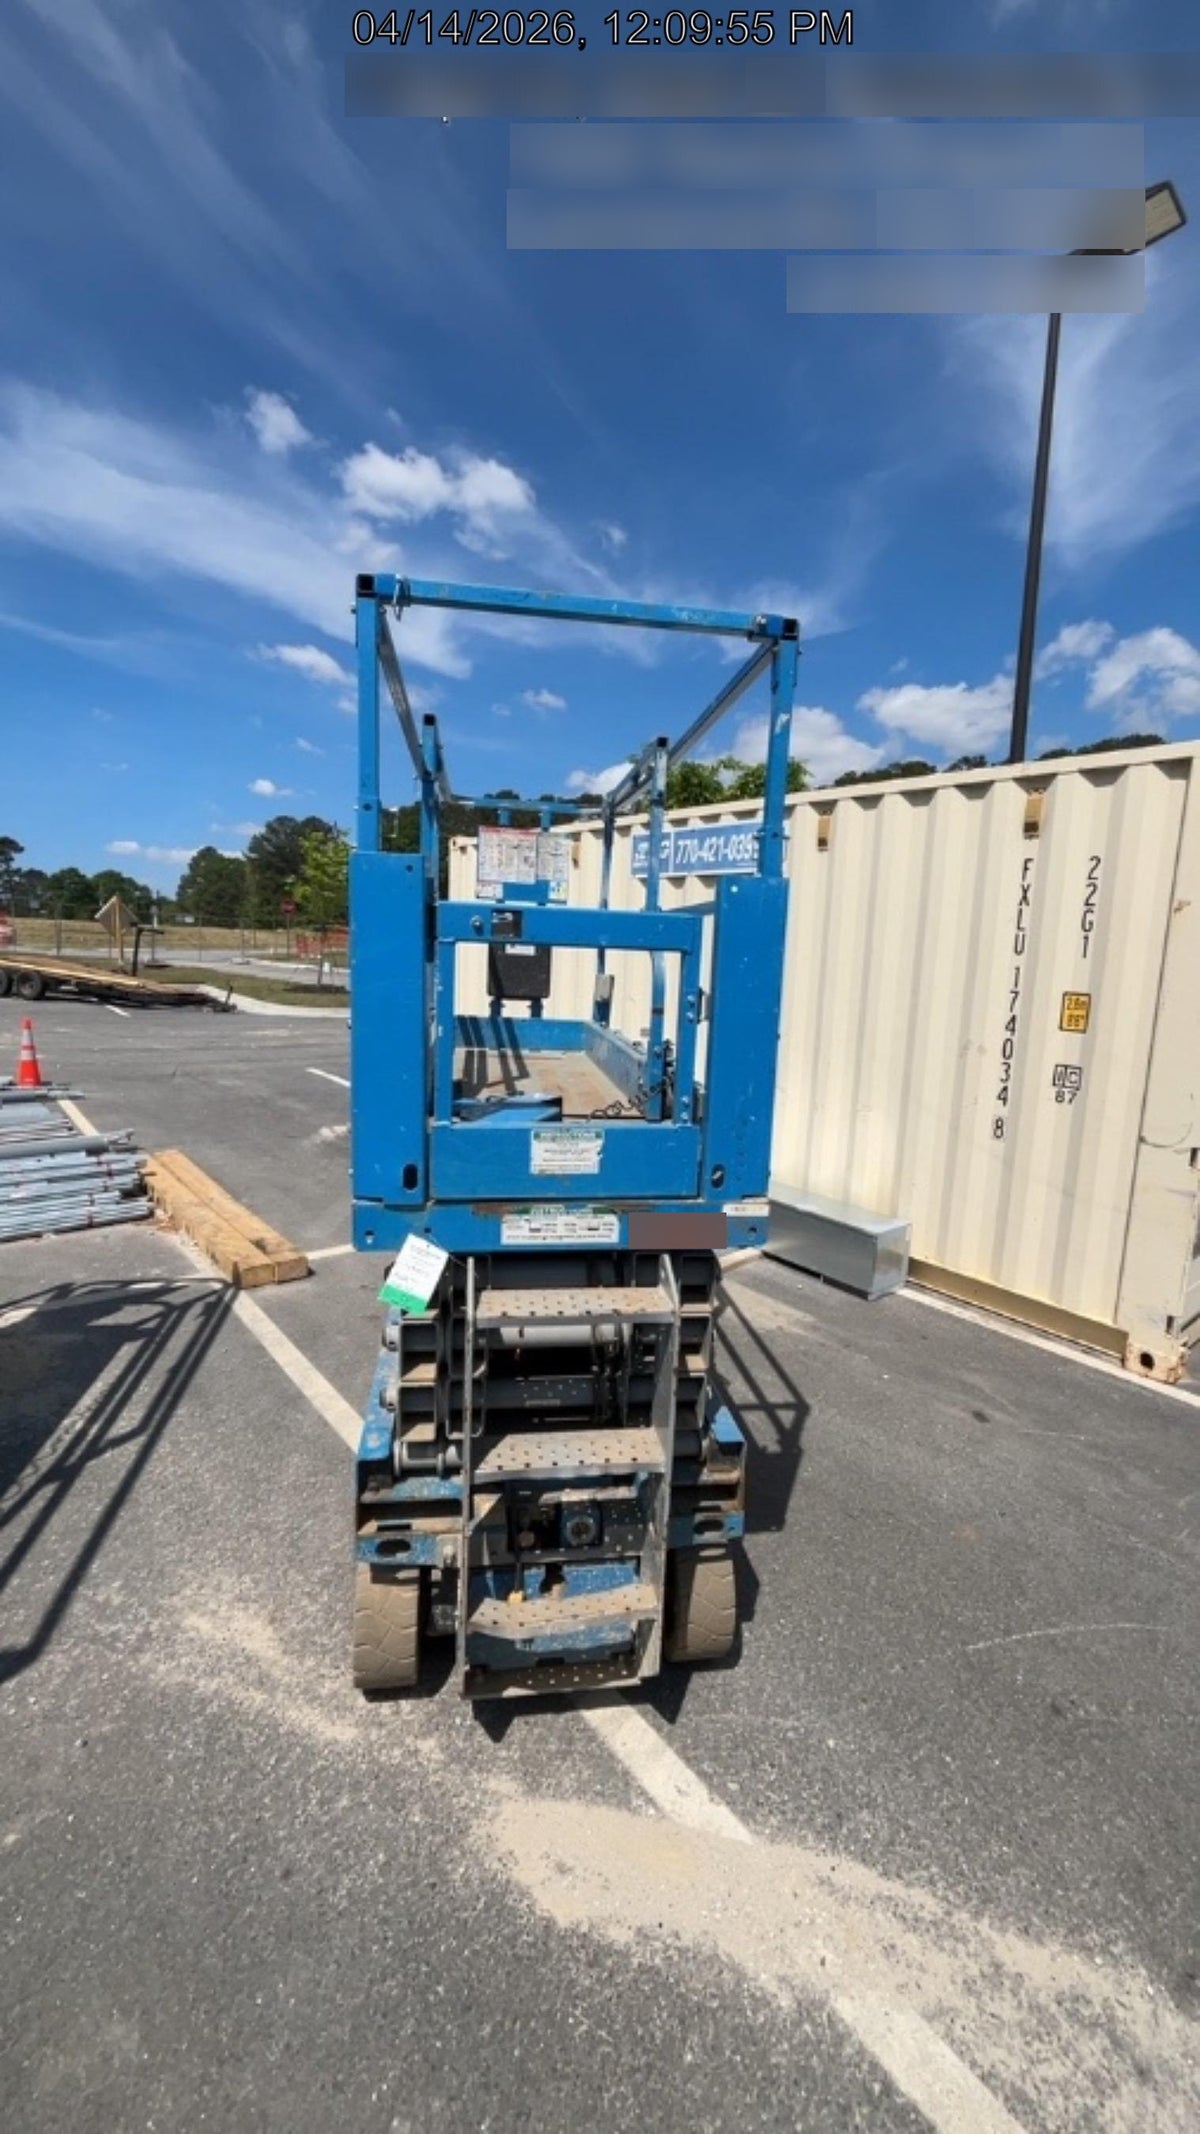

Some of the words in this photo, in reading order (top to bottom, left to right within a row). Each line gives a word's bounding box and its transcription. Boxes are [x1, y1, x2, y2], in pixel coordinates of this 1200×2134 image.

[1014, 858, 1034, 956] FXLU
[1081, 855, 1101, 959] 22G1
[1055, 1090, 1077, 1104] 87
[993, 1117, 1004, 1139] 8
